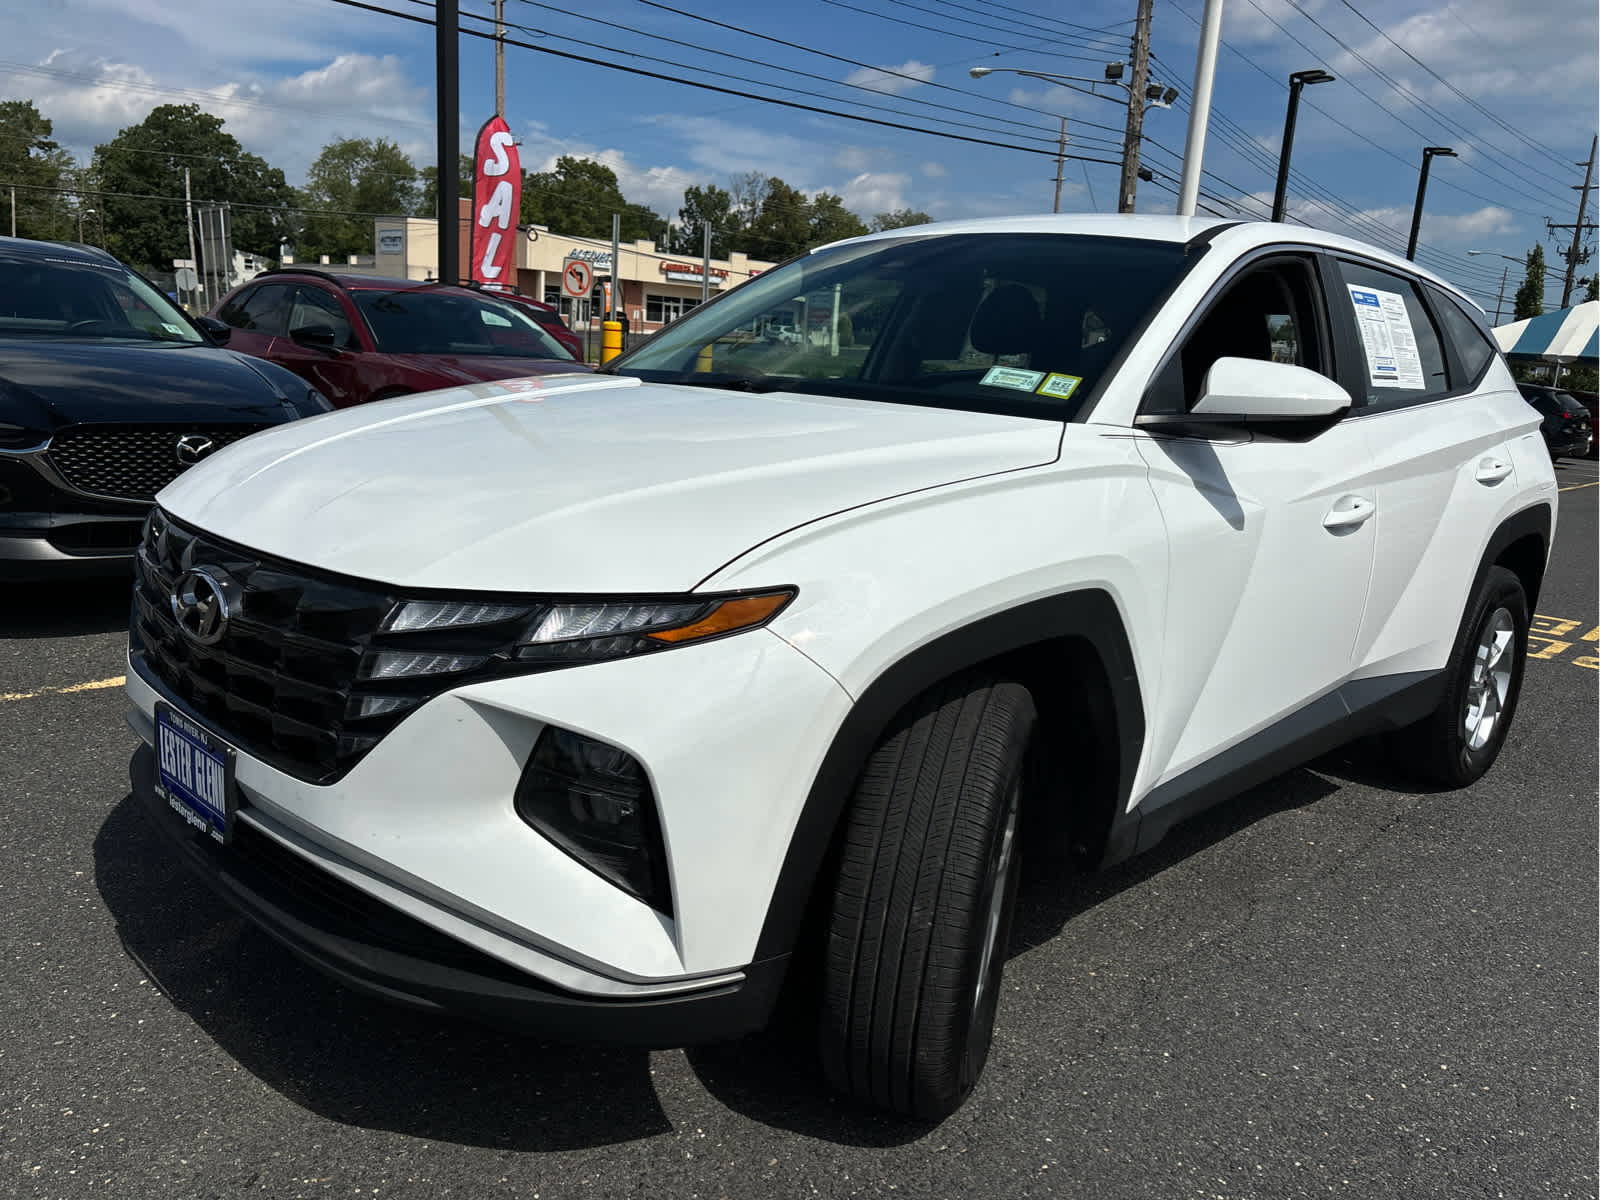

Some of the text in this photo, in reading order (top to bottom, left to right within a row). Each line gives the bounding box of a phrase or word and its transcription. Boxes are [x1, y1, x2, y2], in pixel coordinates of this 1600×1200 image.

[478, 131, 514, 290] SAL
[160, 724, 226, 816] LESTER GLENN
[169, 794, 207, 833] lesterglenn
